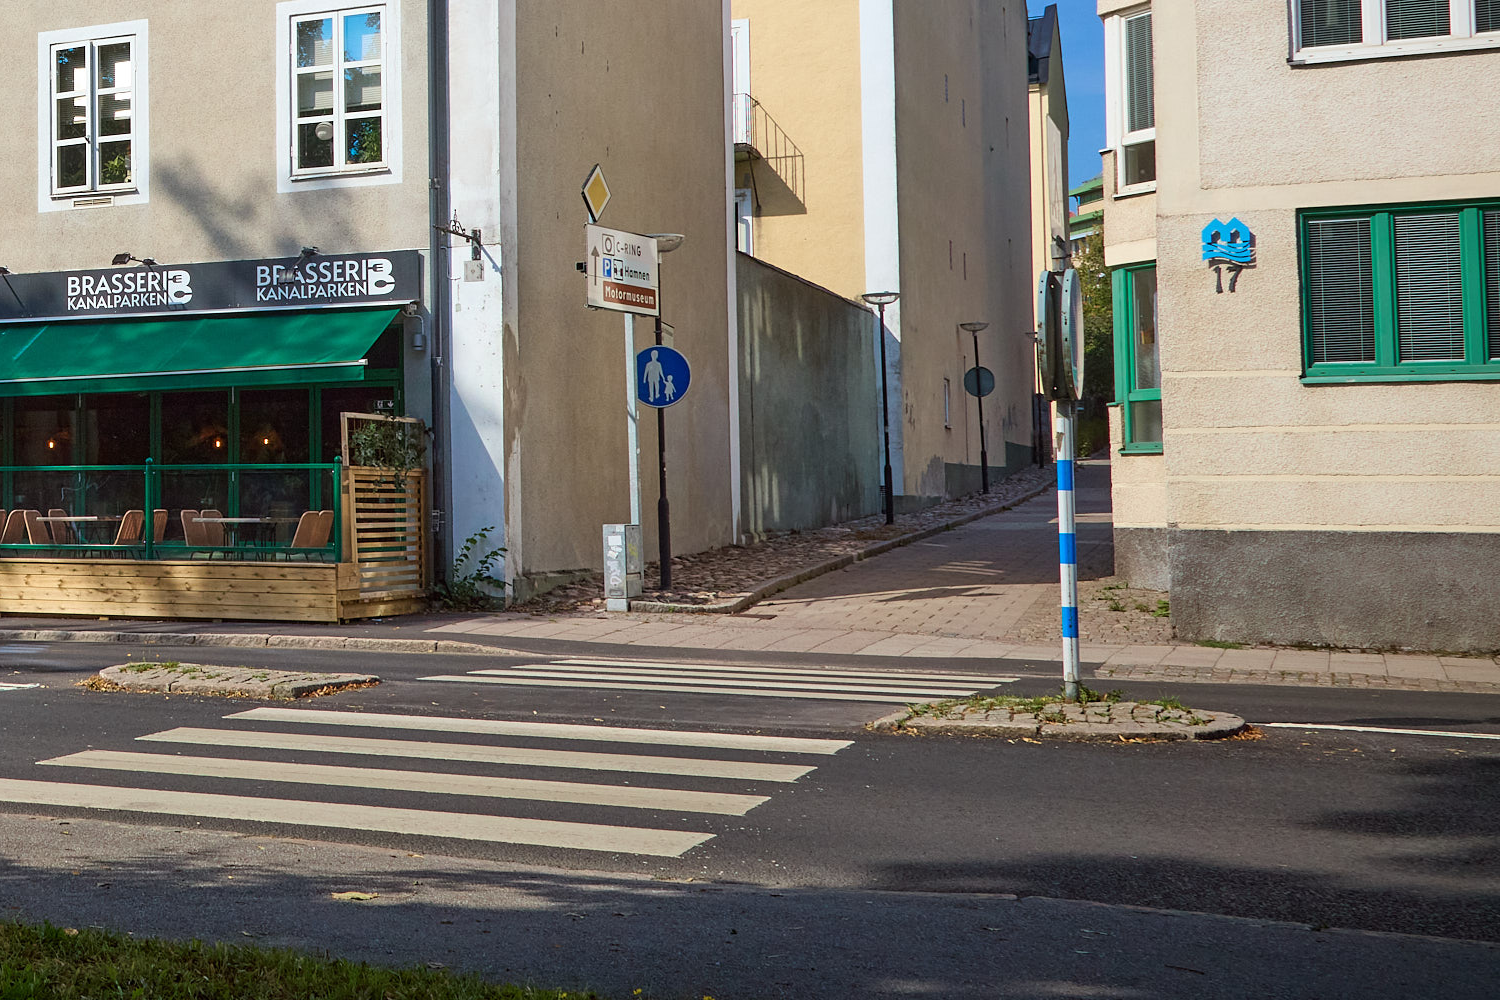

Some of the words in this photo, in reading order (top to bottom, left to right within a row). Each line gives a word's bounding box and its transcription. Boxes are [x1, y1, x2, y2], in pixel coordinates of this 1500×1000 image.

[616, 241, 642, 257] C-RING
[624, 266, 650, 281] Hamnen
[1212, 265, 1243, 294] 17
[257, 281, 367, 301] KANALPARKEN
[605, 286, 655, 304] Motormuseum
[67, 292, 167, 310] KANALPARKEN
